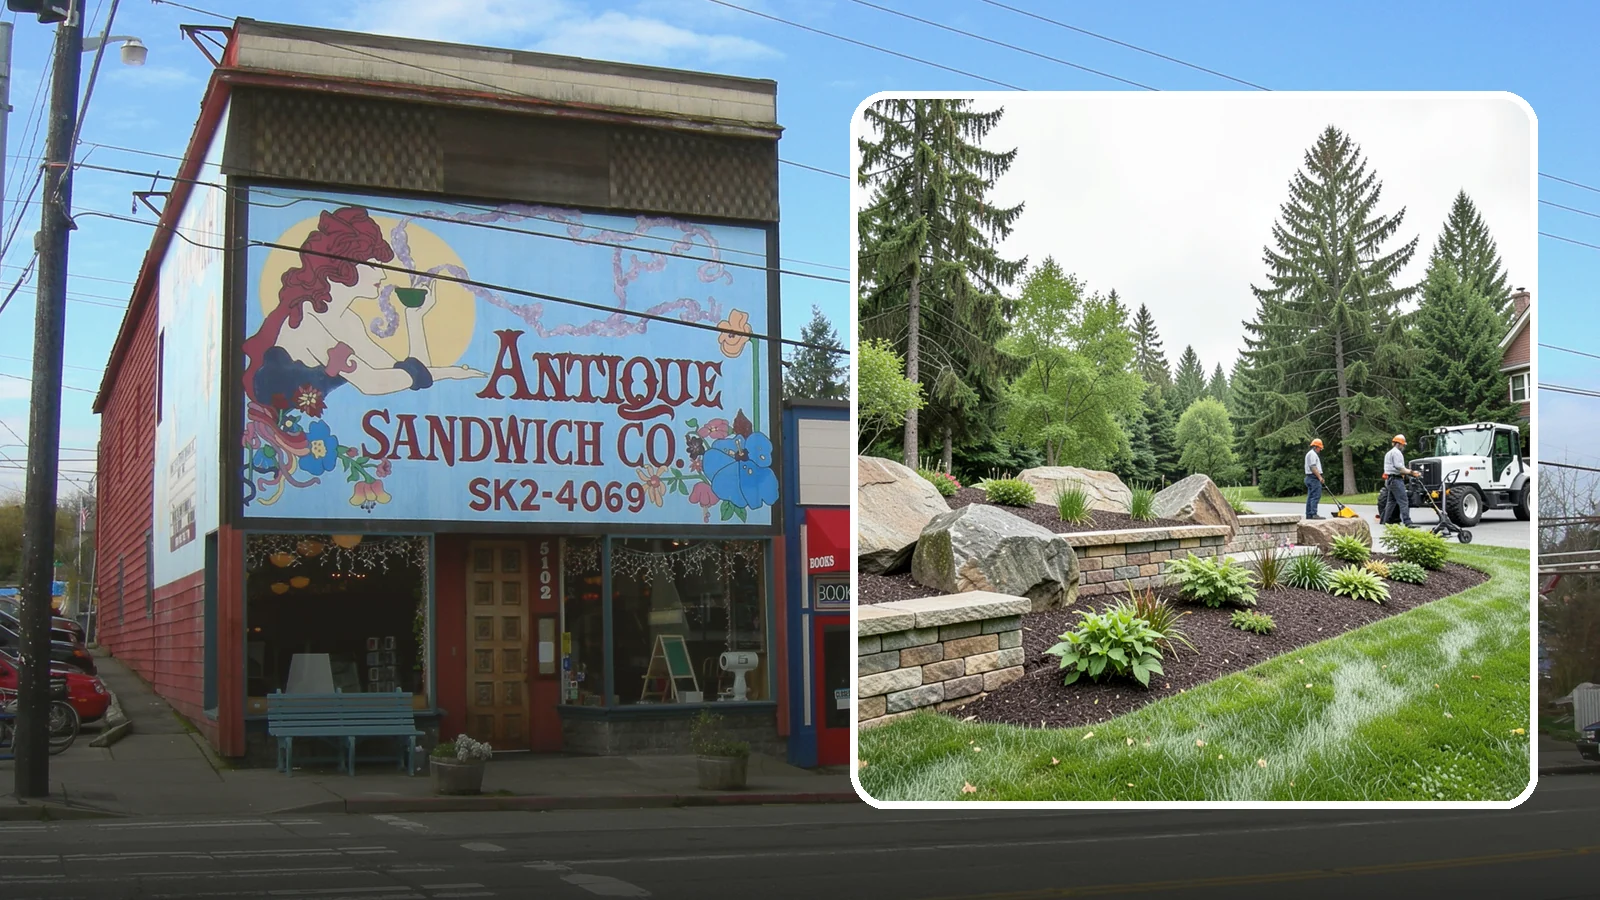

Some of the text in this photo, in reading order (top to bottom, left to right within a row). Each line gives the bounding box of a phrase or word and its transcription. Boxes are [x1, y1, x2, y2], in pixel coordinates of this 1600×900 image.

[476, 329, 723, 420] ANTIQUE
[361, 408, 684, 468] SANDWICH CO.
[468, 477, 646, 513] SK2-4069
[540, 541, 551, 599] 5102
[809, 555, 835, 568] BOOKS
